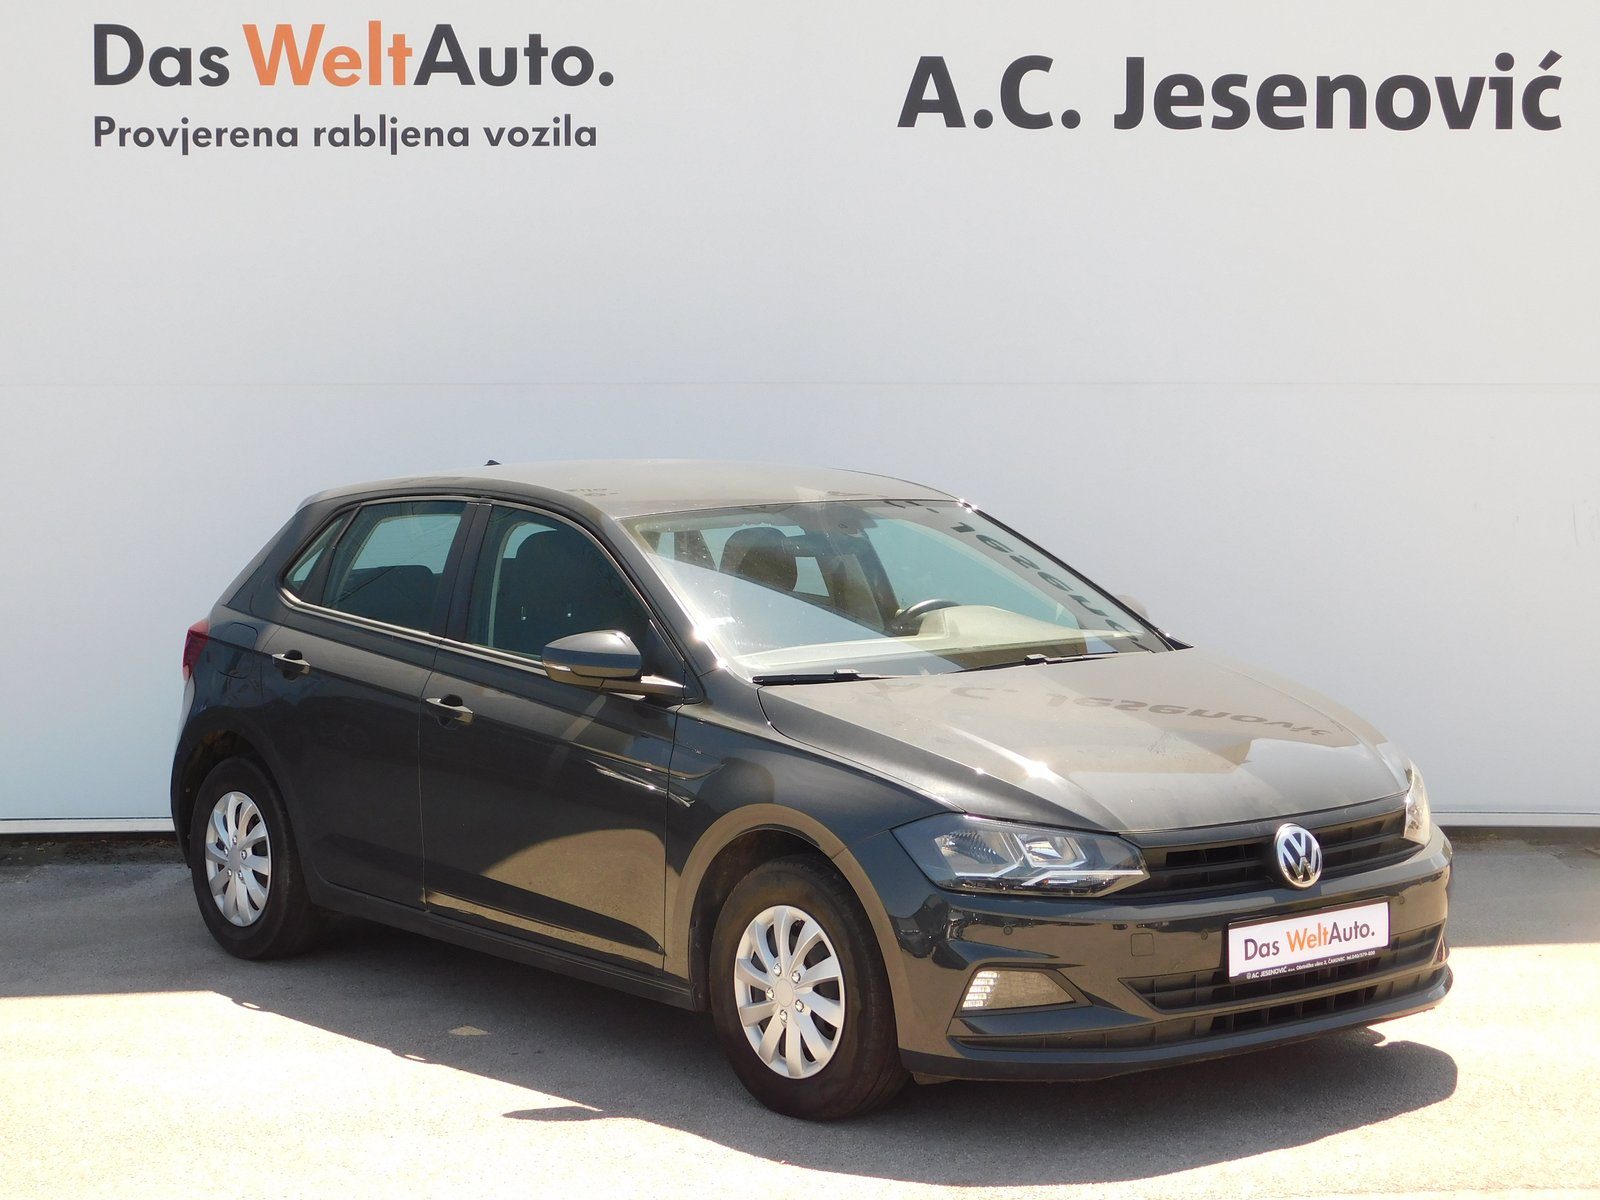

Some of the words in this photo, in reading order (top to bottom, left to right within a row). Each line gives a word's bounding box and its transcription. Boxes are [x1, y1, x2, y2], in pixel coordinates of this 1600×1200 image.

[93, 23, 230, 87] Das
[242, 20, 614, 87] WeltAuto.
[896, 54, 1081, 130] A.C.
[1113, 49, 1563, 131] Jesenović
[94, 115, 298, 156] Provjerena
[313, 113, 469, 156] rabljena
[482, 113, 597, 148] vozila
[1243, 938, 1280, 961] Das
[1286, 921, 1375, 953] WeltAuto.
